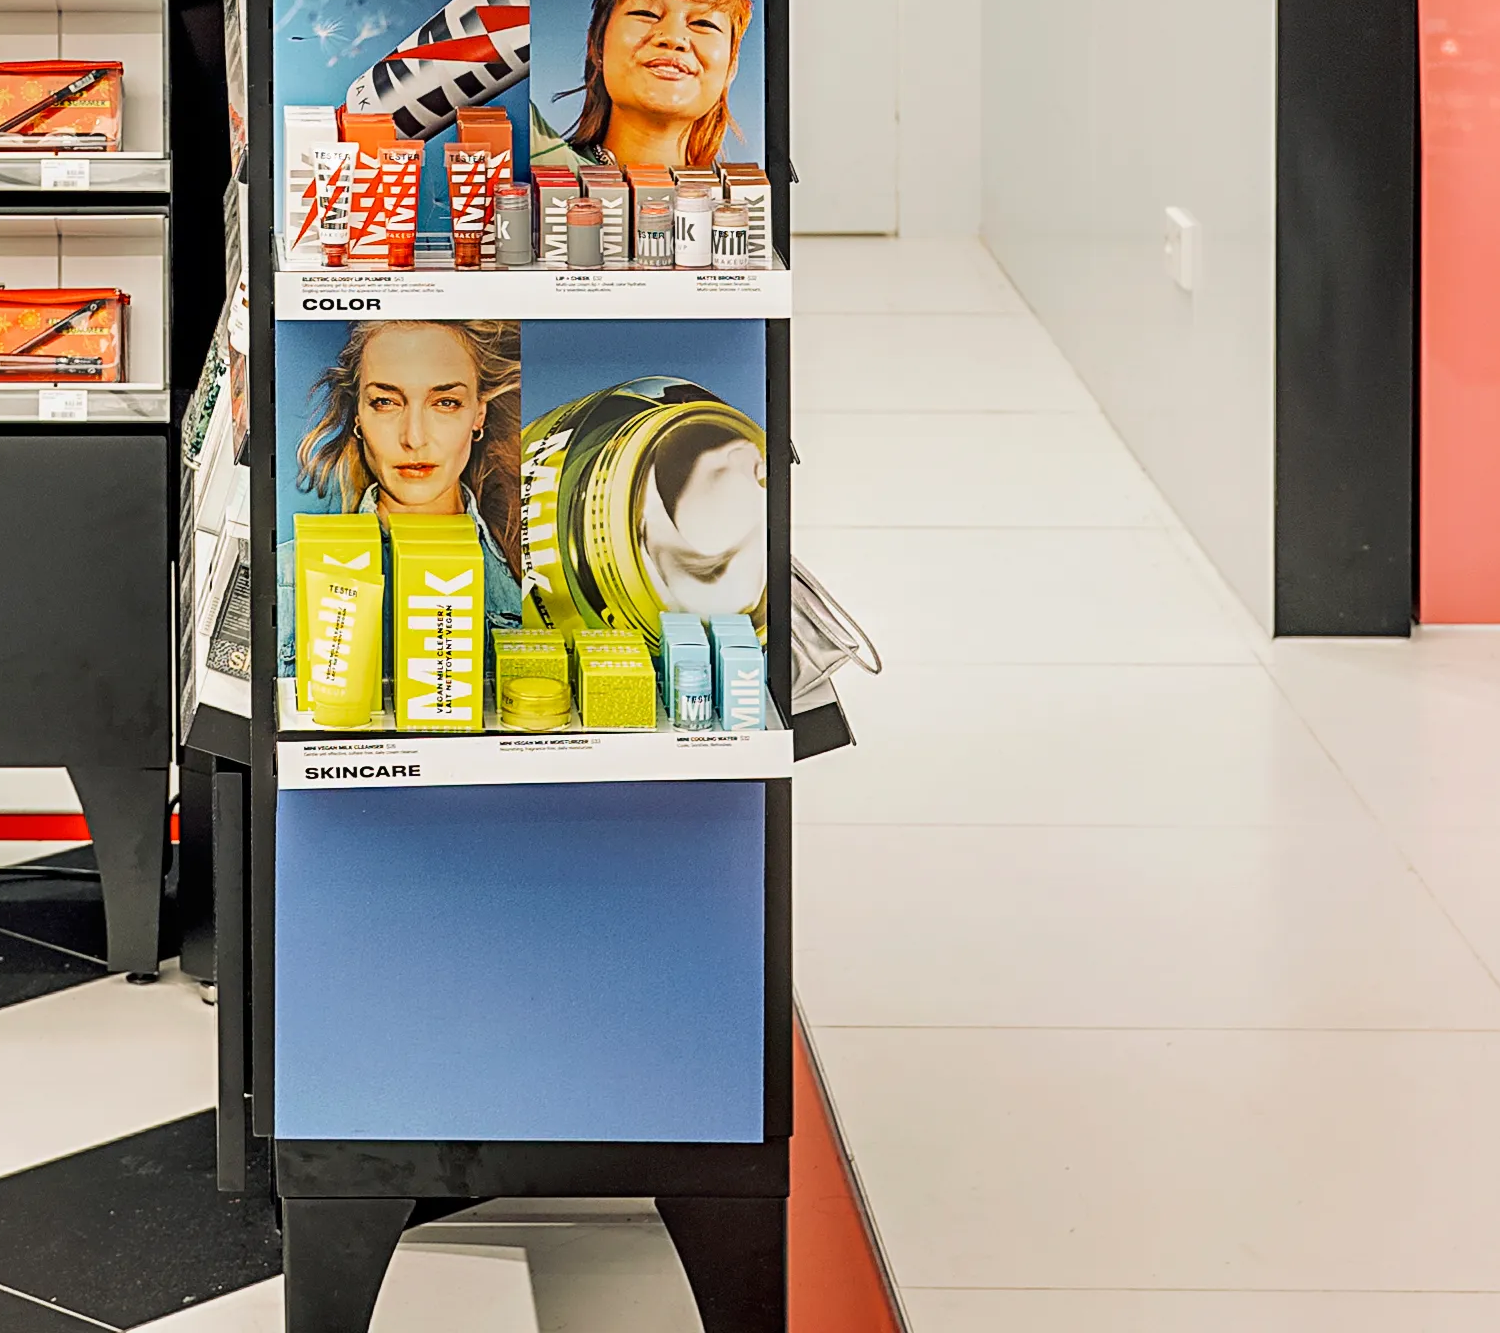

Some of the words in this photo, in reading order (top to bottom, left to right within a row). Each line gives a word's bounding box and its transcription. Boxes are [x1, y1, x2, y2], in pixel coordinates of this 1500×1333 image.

[66, 98, 107, 107] SUMMER
[314, 151, 351, 161] TESTER
[383, 152, 420, 161] TESTER
[449, 154, 486, 163] TESTER
[302, 298, 381, 311] COLOR
[329, 584, 358, 598] TESTER
[407, 568, 474, 721] Milk
[730, 667, 761, 731] Milk
[304, 764, 421, 780] SKINCARE
